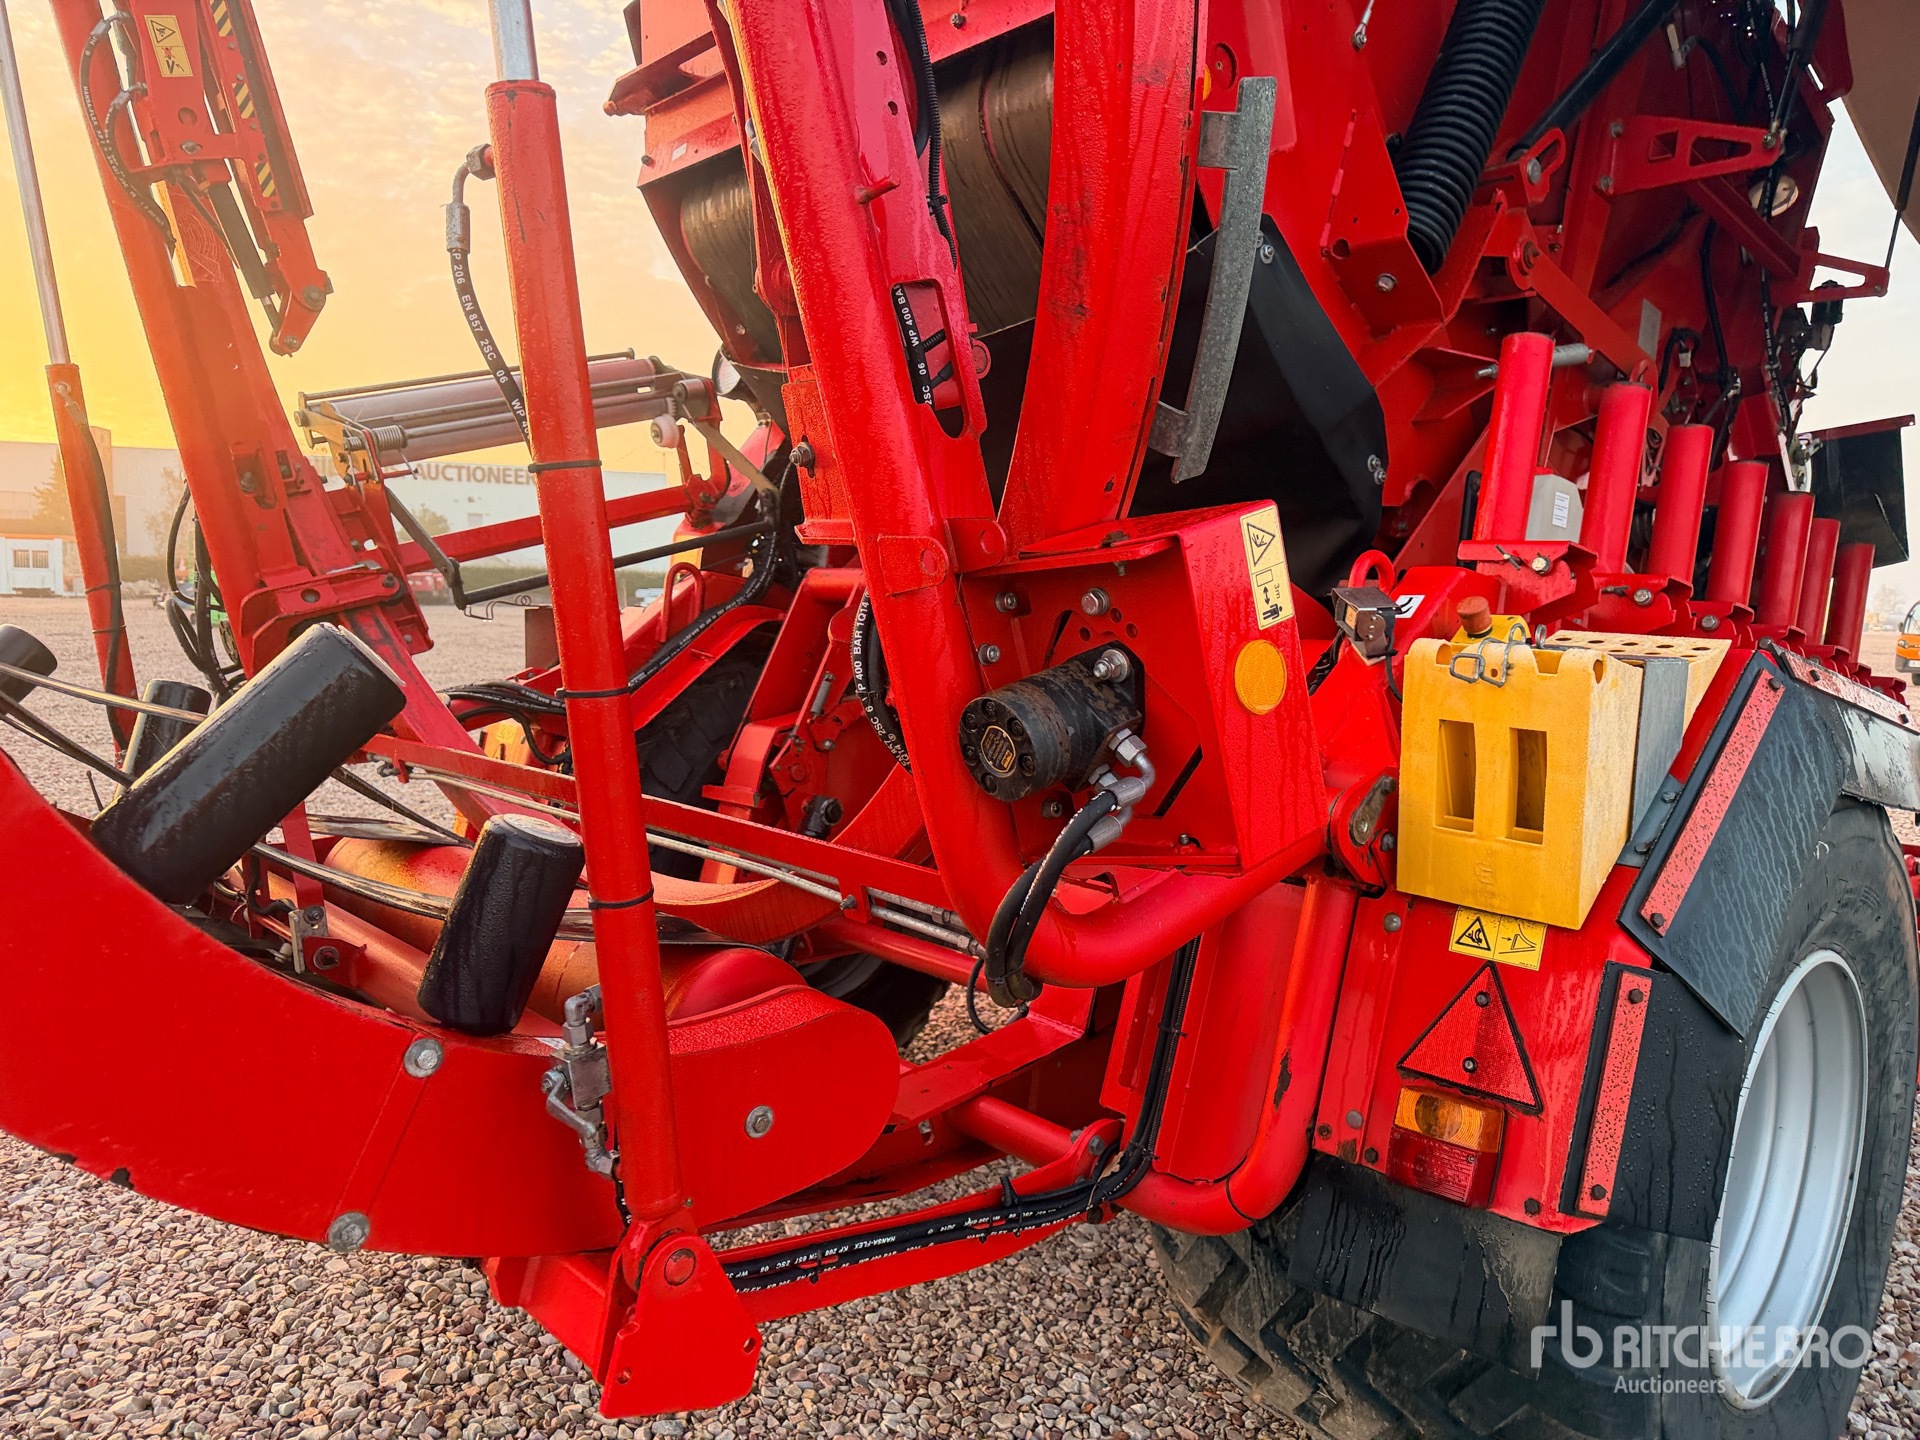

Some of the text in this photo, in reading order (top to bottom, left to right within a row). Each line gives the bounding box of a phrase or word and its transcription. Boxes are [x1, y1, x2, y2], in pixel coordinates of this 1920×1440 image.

[901, 307, 913, 326] 400
[453, 264, 466, 285] 206
[461, 294, 474, 311] EN
[468, 312, 483, 333] 857
[479, 338, 497, 362] 2SC
[496, 369, 508, 385] 06
[511, 398, 526, 417] WP
[908, 329, 920, 347] WP
[917, 362, 927, 375] 06
[857, 602, 869, 627] 1Q14
[853, 631, 863, 654] BAR
[870, 716, 887, 736] 2SC
[838, 1245, 849, 1253] KP
[853, 1235, 896, 1250] HANSA-FLEX
[775, 1260, 791, 1269] 2SC
[736, 1270, 749, 1278] WP
